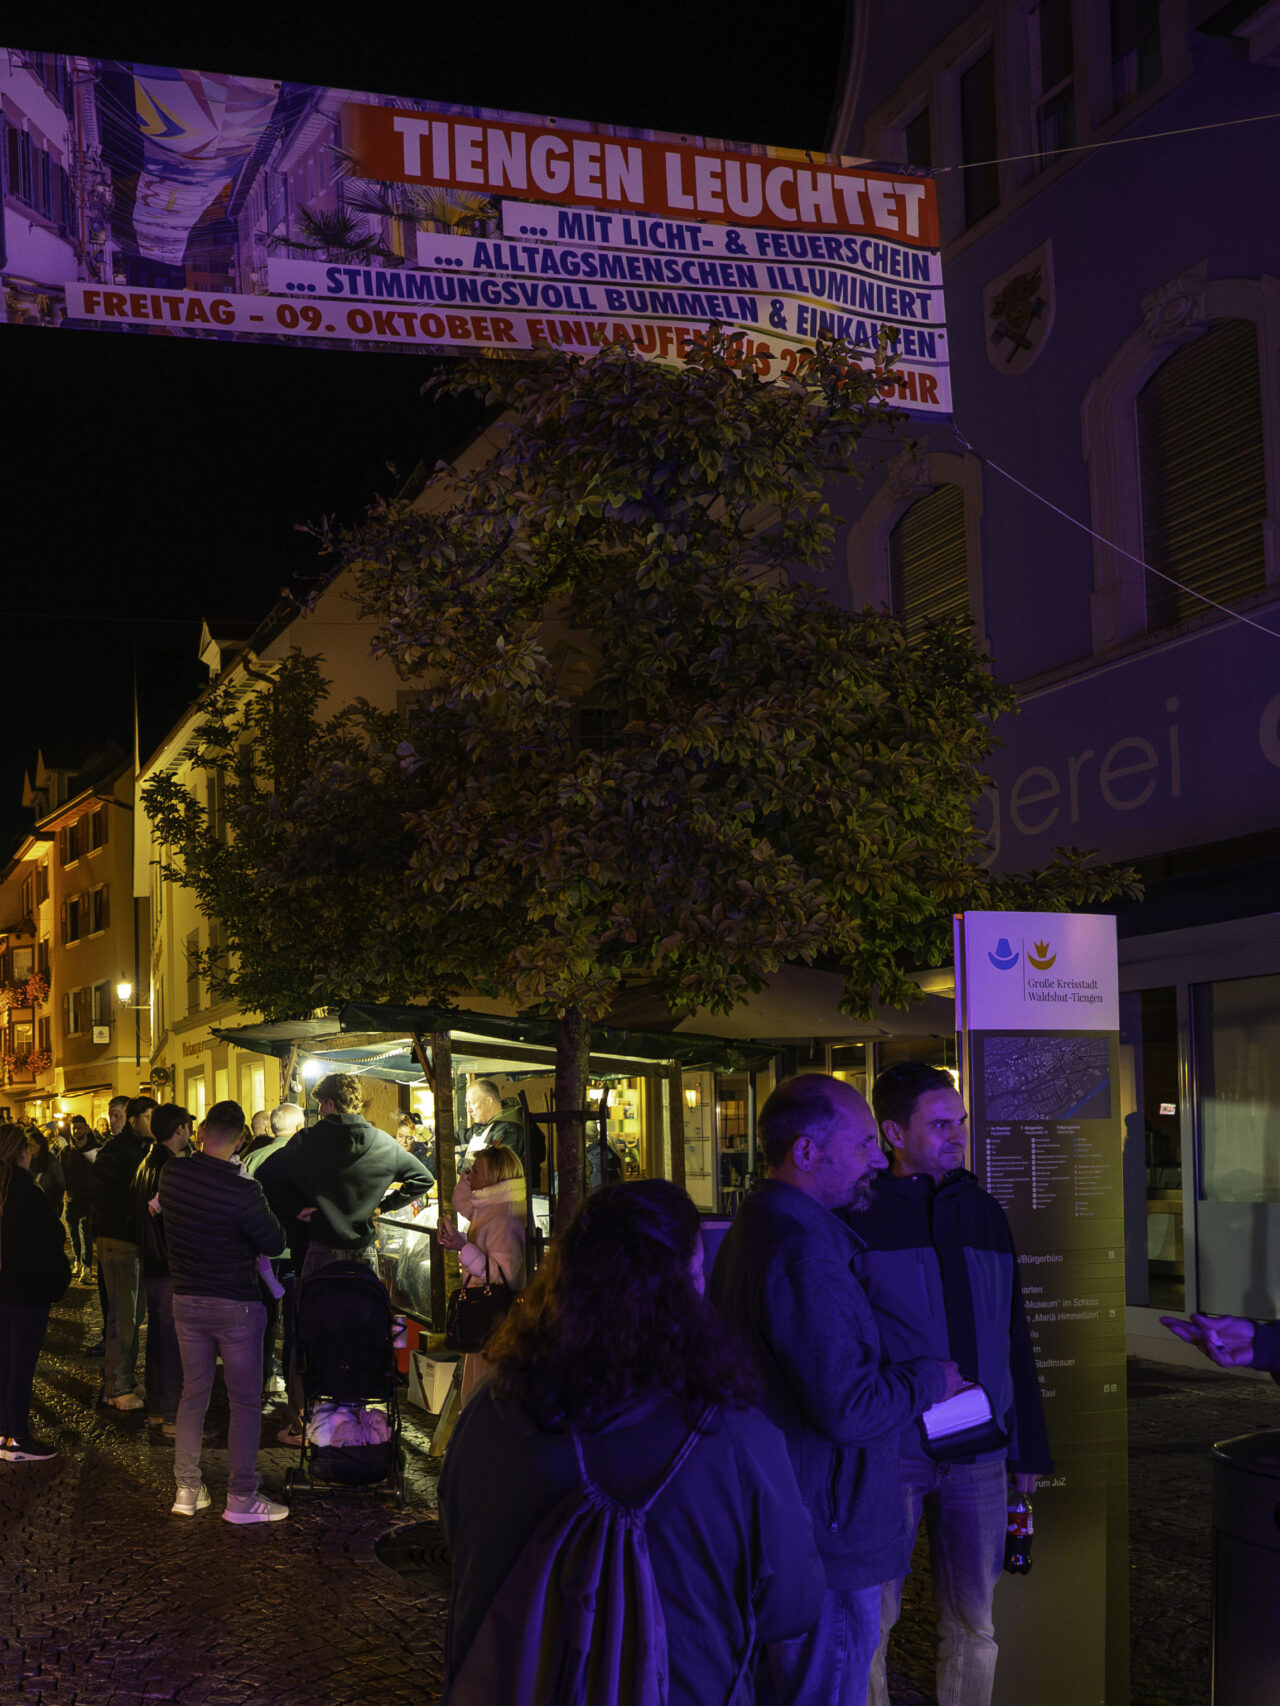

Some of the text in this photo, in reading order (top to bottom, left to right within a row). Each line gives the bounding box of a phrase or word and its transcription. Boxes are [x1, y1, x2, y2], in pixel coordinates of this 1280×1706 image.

[393, 116, 926, 238] TIENGEN LEUCHTET
[558, 211, 612, 242] MIT
[622, 217, 714, 250] LICHT-
[725, 229, 749, 255] &
[755, 231, 930, 282] FEUERSCHEIN
[326, 267, 597, 310] STIMMUNGSVOLL
[604, 288, 758, 323] BUMMELN
[768, 299, 787, 331] &
[473, 241, 758, 288] ALLTAGSMENSCHEN
[766, 266, 932, 320] ILLUMINIERT
[82, 290, 235, 325] FREITAG
[276, 303, 336, 332] 09.
[346, 308, 518, 343] OKTOBER
[1027, 978, 1098, 990] Große Kreisstadt
[1028, 991, 1103, 1004] Waldshut-Tiengen
